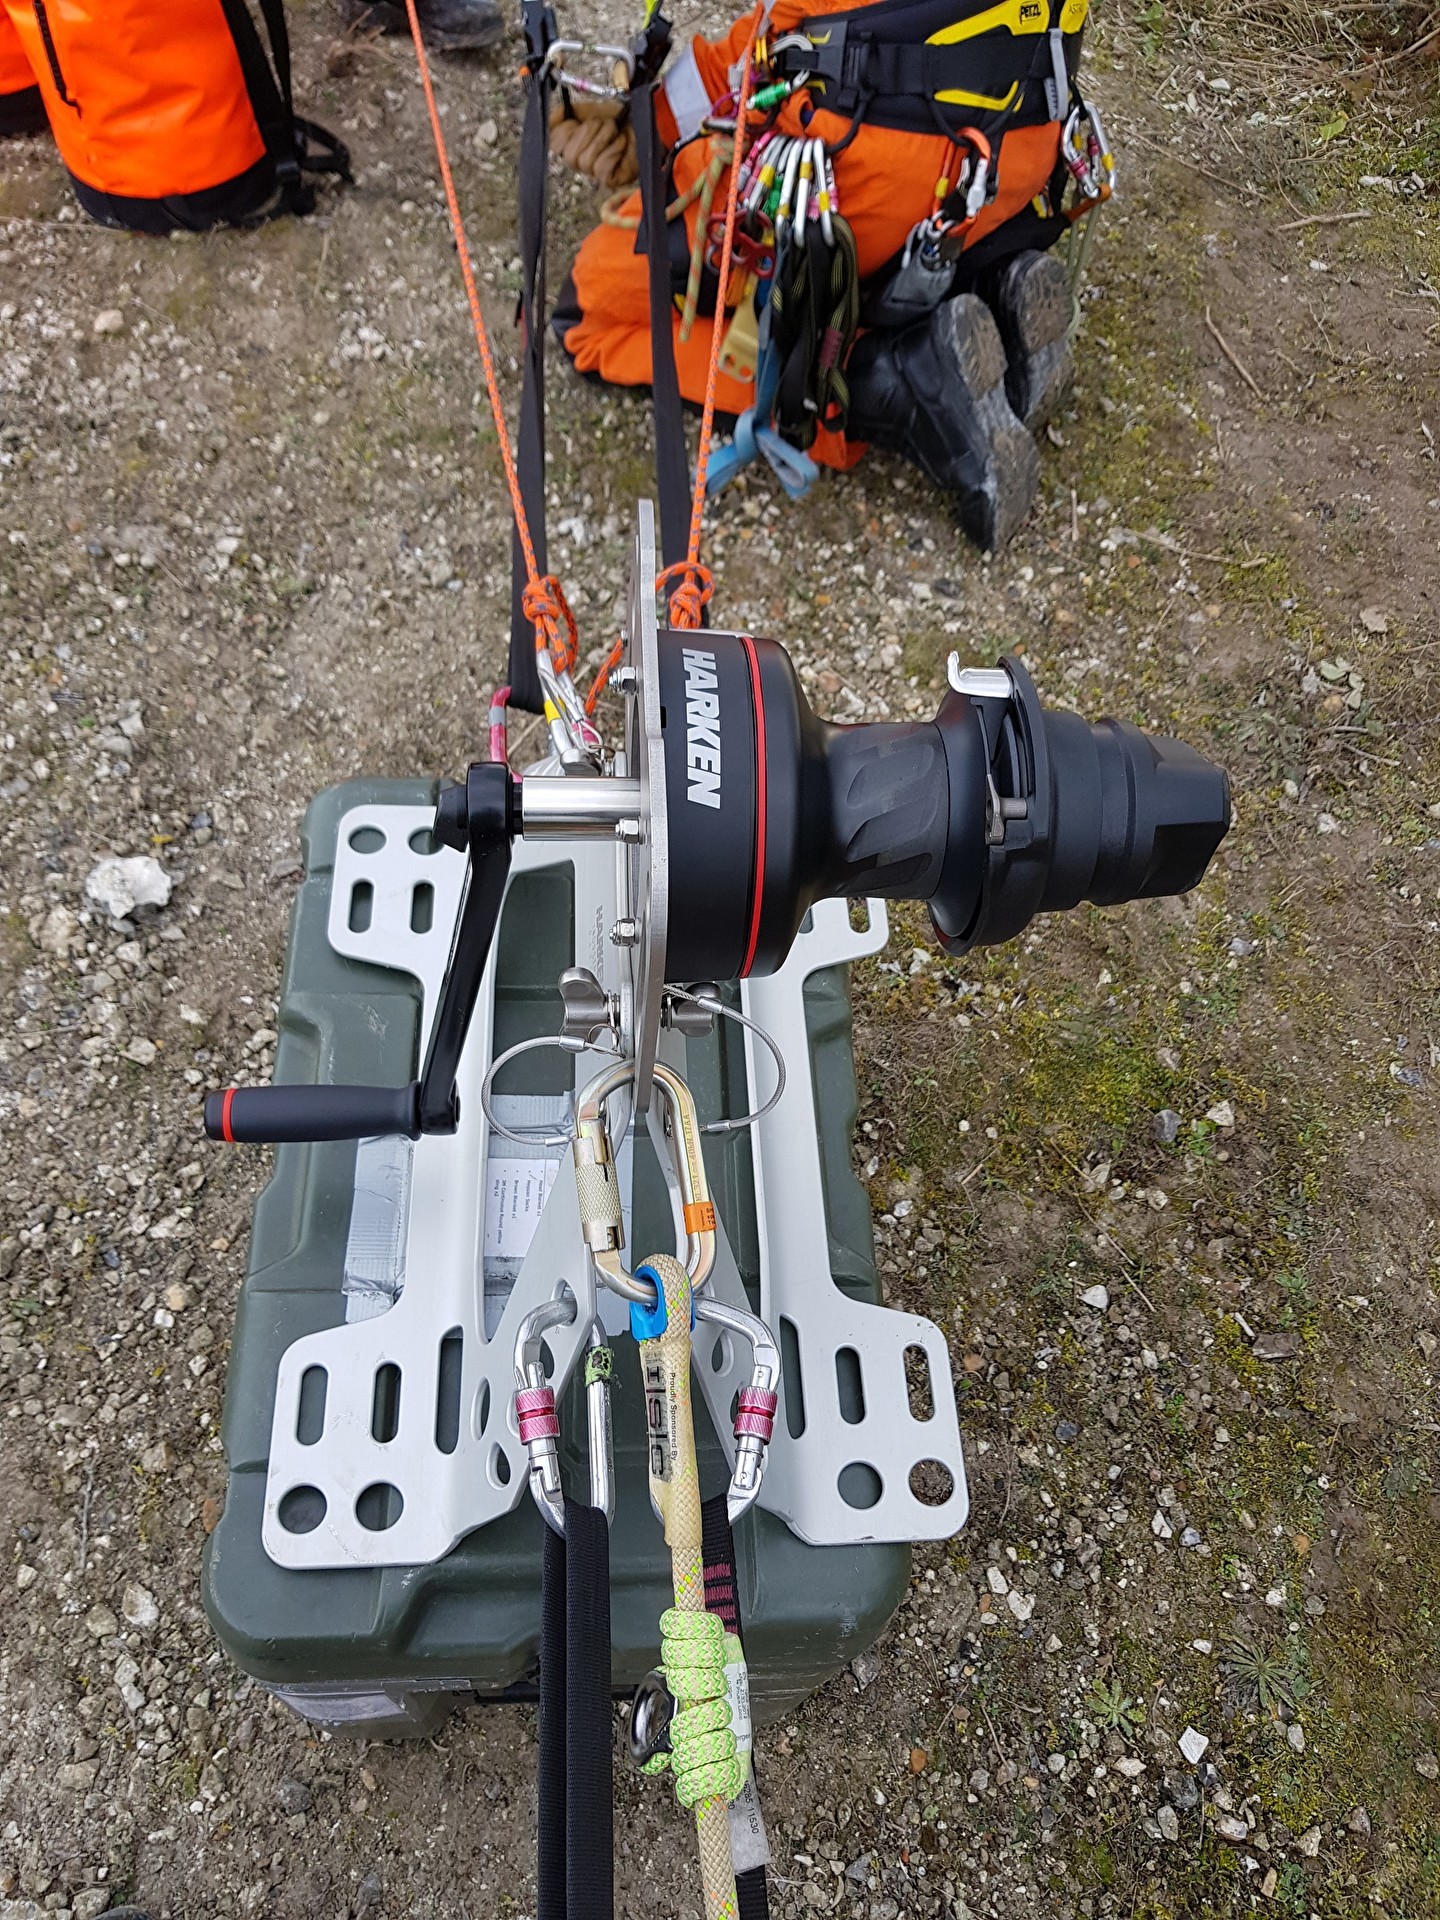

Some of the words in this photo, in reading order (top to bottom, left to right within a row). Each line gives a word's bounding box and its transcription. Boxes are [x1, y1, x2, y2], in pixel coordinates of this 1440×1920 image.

[682, 648, 721, 809] HARKEN
[596, 904, 604, 986] HARKE
[670, 1405, 678, 1449] Sponsored
[671, 1450, 678, 1461] By
[747, 1807, 759, 1834] 11530
